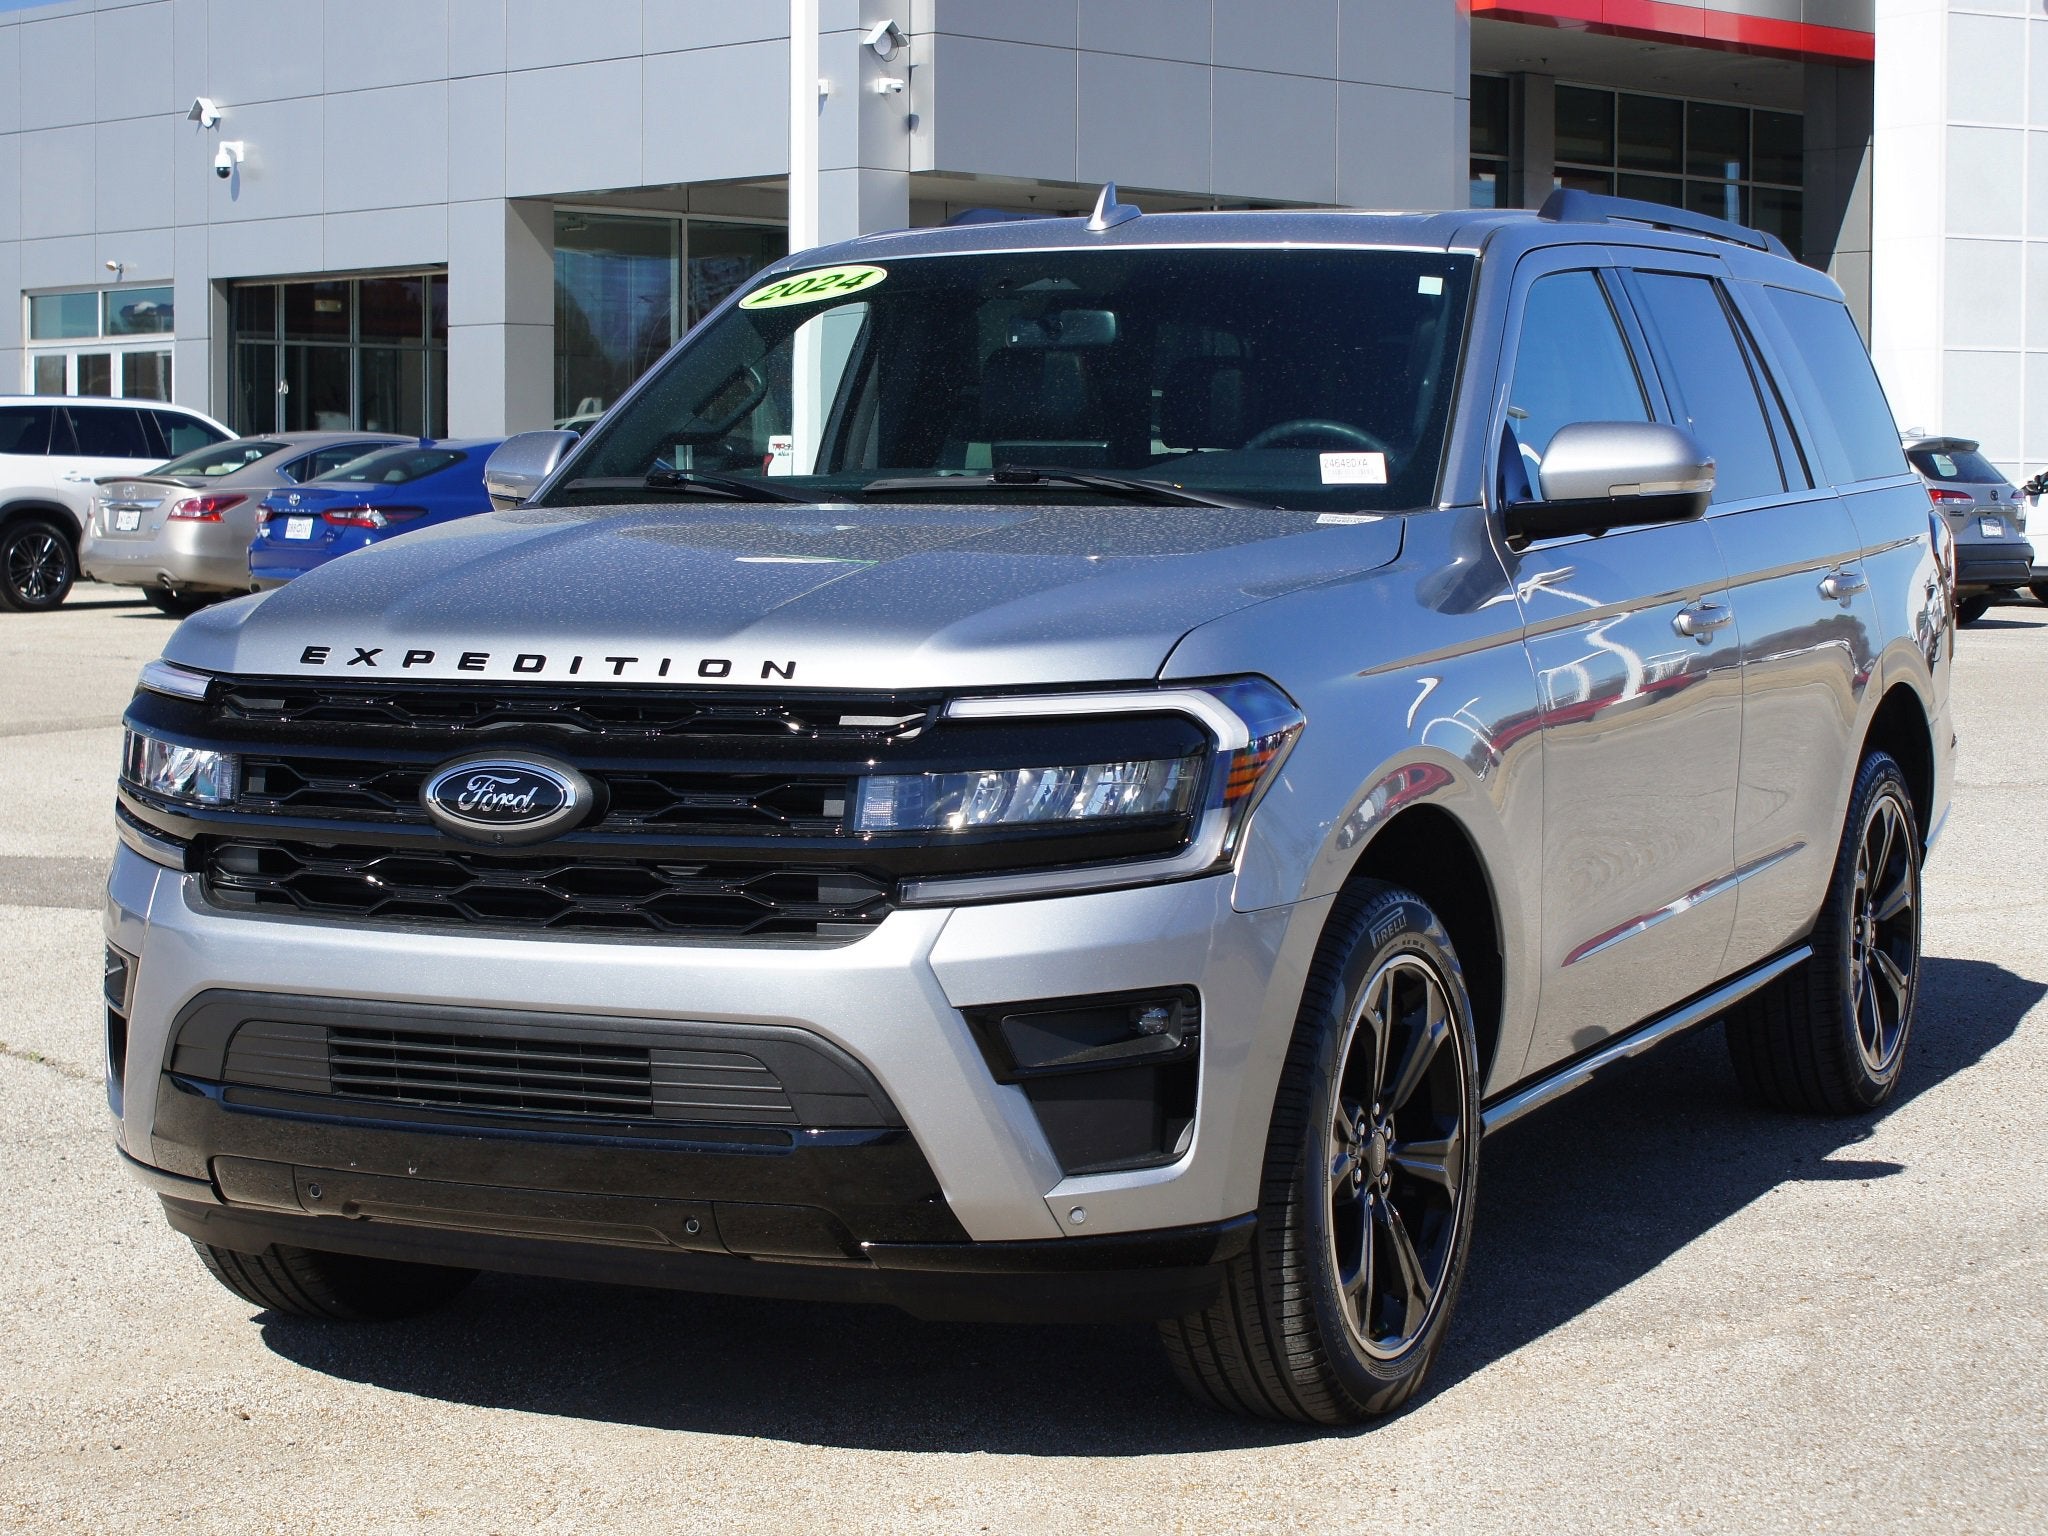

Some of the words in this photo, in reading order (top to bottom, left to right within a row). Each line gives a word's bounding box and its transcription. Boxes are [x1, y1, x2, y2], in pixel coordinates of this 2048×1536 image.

[750, 271, 875, 304] 2024
[299, 645, 797, 680] EXPEDITION
[457, 774, 539, 814] Ford
[1368, 906, 1408, 950] PIRELLI
